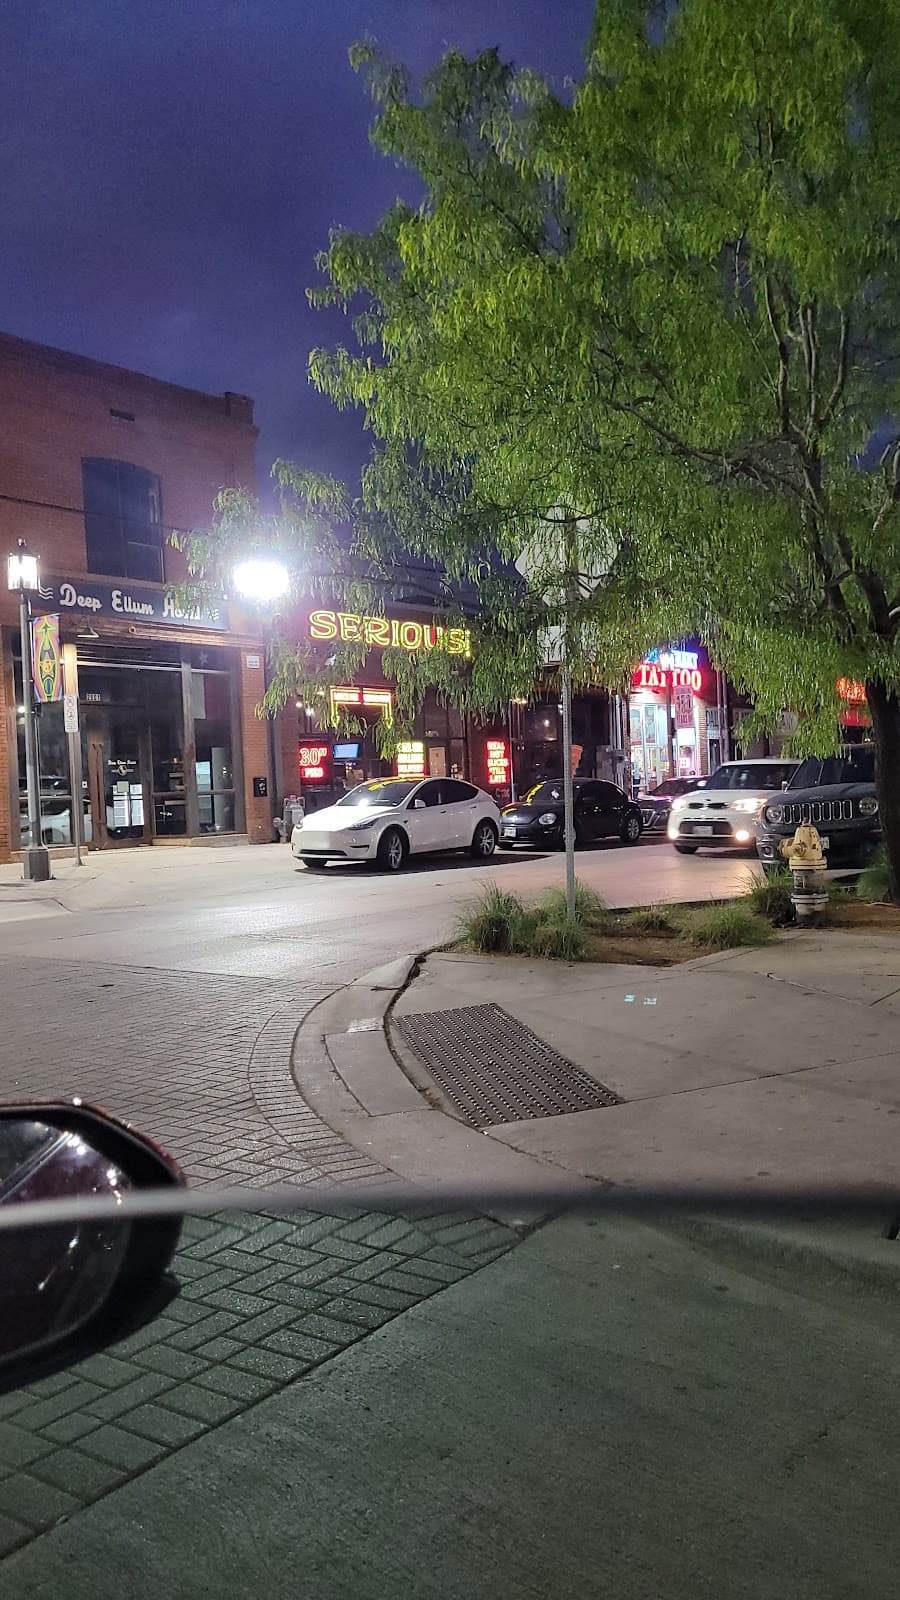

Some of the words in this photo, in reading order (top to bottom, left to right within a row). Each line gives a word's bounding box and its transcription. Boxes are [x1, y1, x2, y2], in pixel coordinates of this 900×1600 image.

[59, 583, 102, 612] Deep
[111, 589, 155, 615] Ellum
[637, 663, 702, 691] TATTOO
[299, 747, 327, 767] 30"
